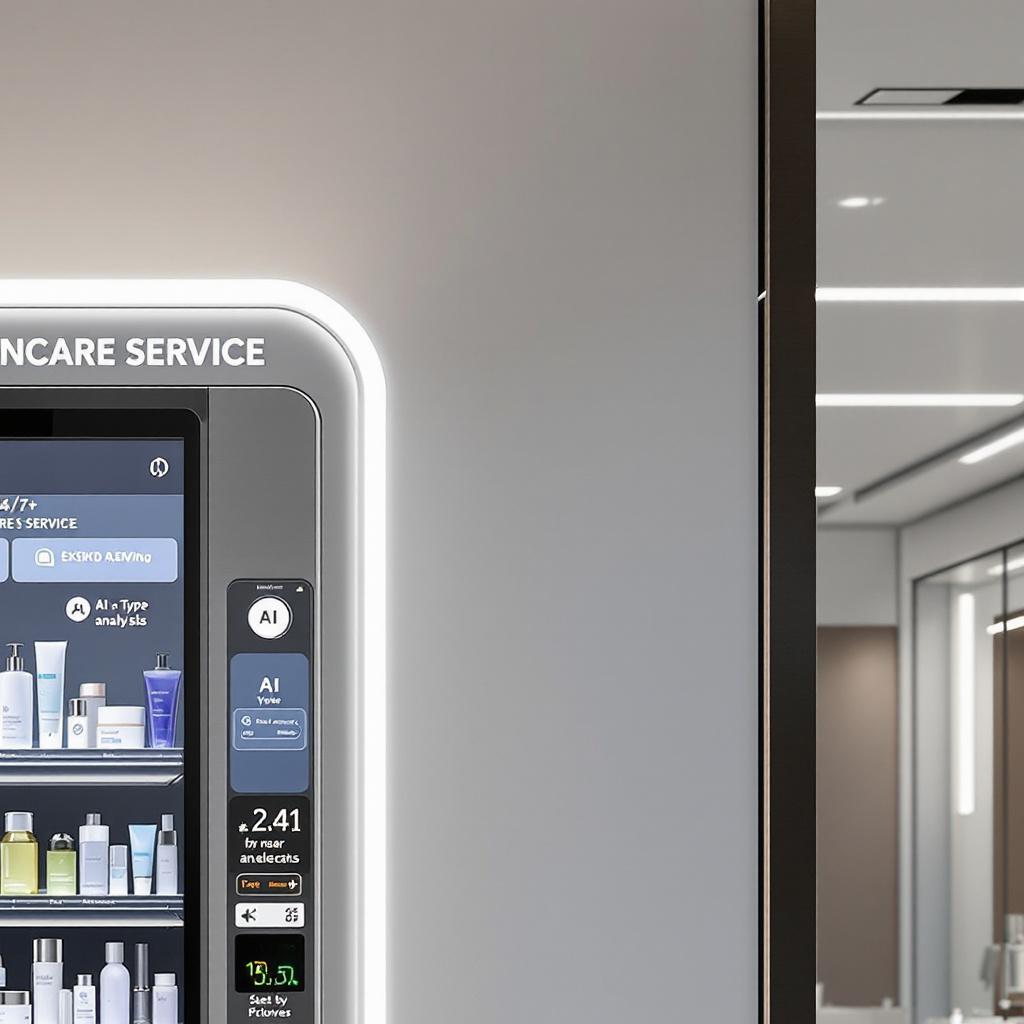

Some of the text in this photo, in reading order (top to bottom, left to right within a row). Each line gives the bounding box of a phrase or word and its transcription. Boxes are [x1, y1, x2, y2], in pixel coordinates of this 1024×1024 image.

[125, 337, 265, 367] SERVICE
[26, 517, 78, 529] SERVICE
[259, 610, 278, 625] AI
[259, 677, 280, 693] AI
